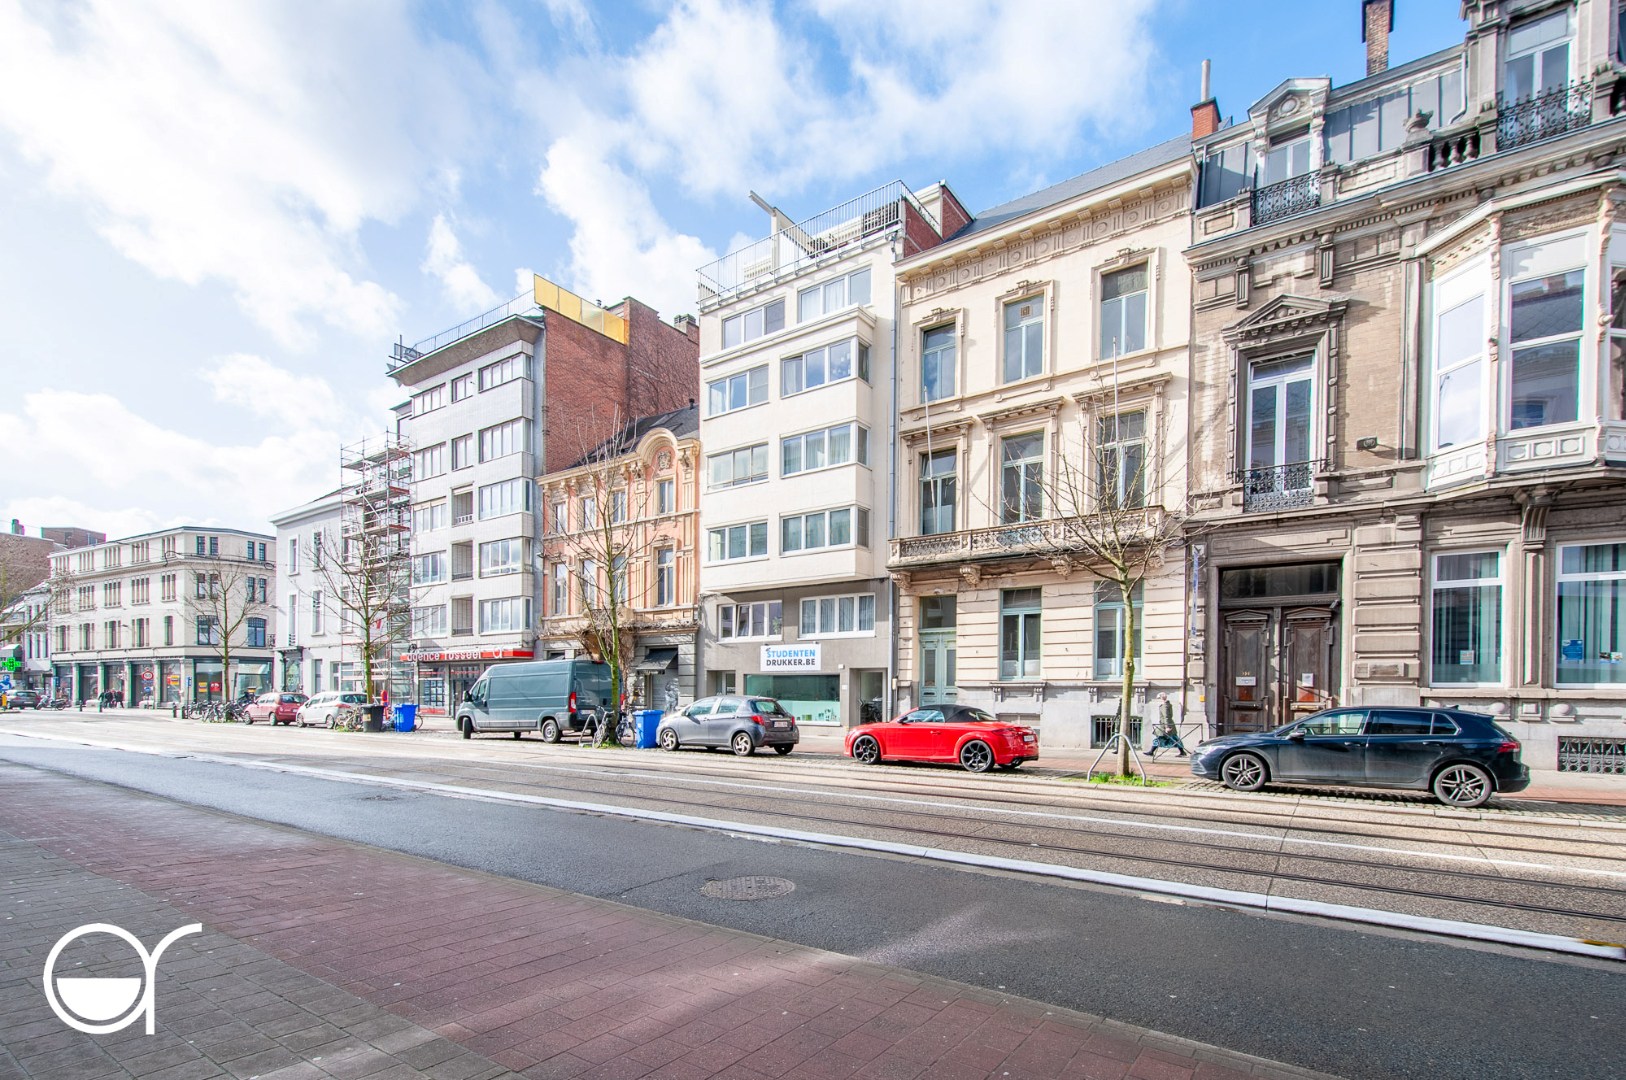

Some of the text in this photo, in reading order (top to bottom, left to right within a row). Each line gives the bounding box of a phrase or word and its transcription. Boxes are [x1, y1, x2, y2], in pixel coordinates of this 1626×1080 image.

[407, 652, 440, 663] agence
[444, 651, 482, 661] rosseel
[767, 649, 816, 658] STUDENTEN
[766, 658, 816, 666] DRUKKER.BE
